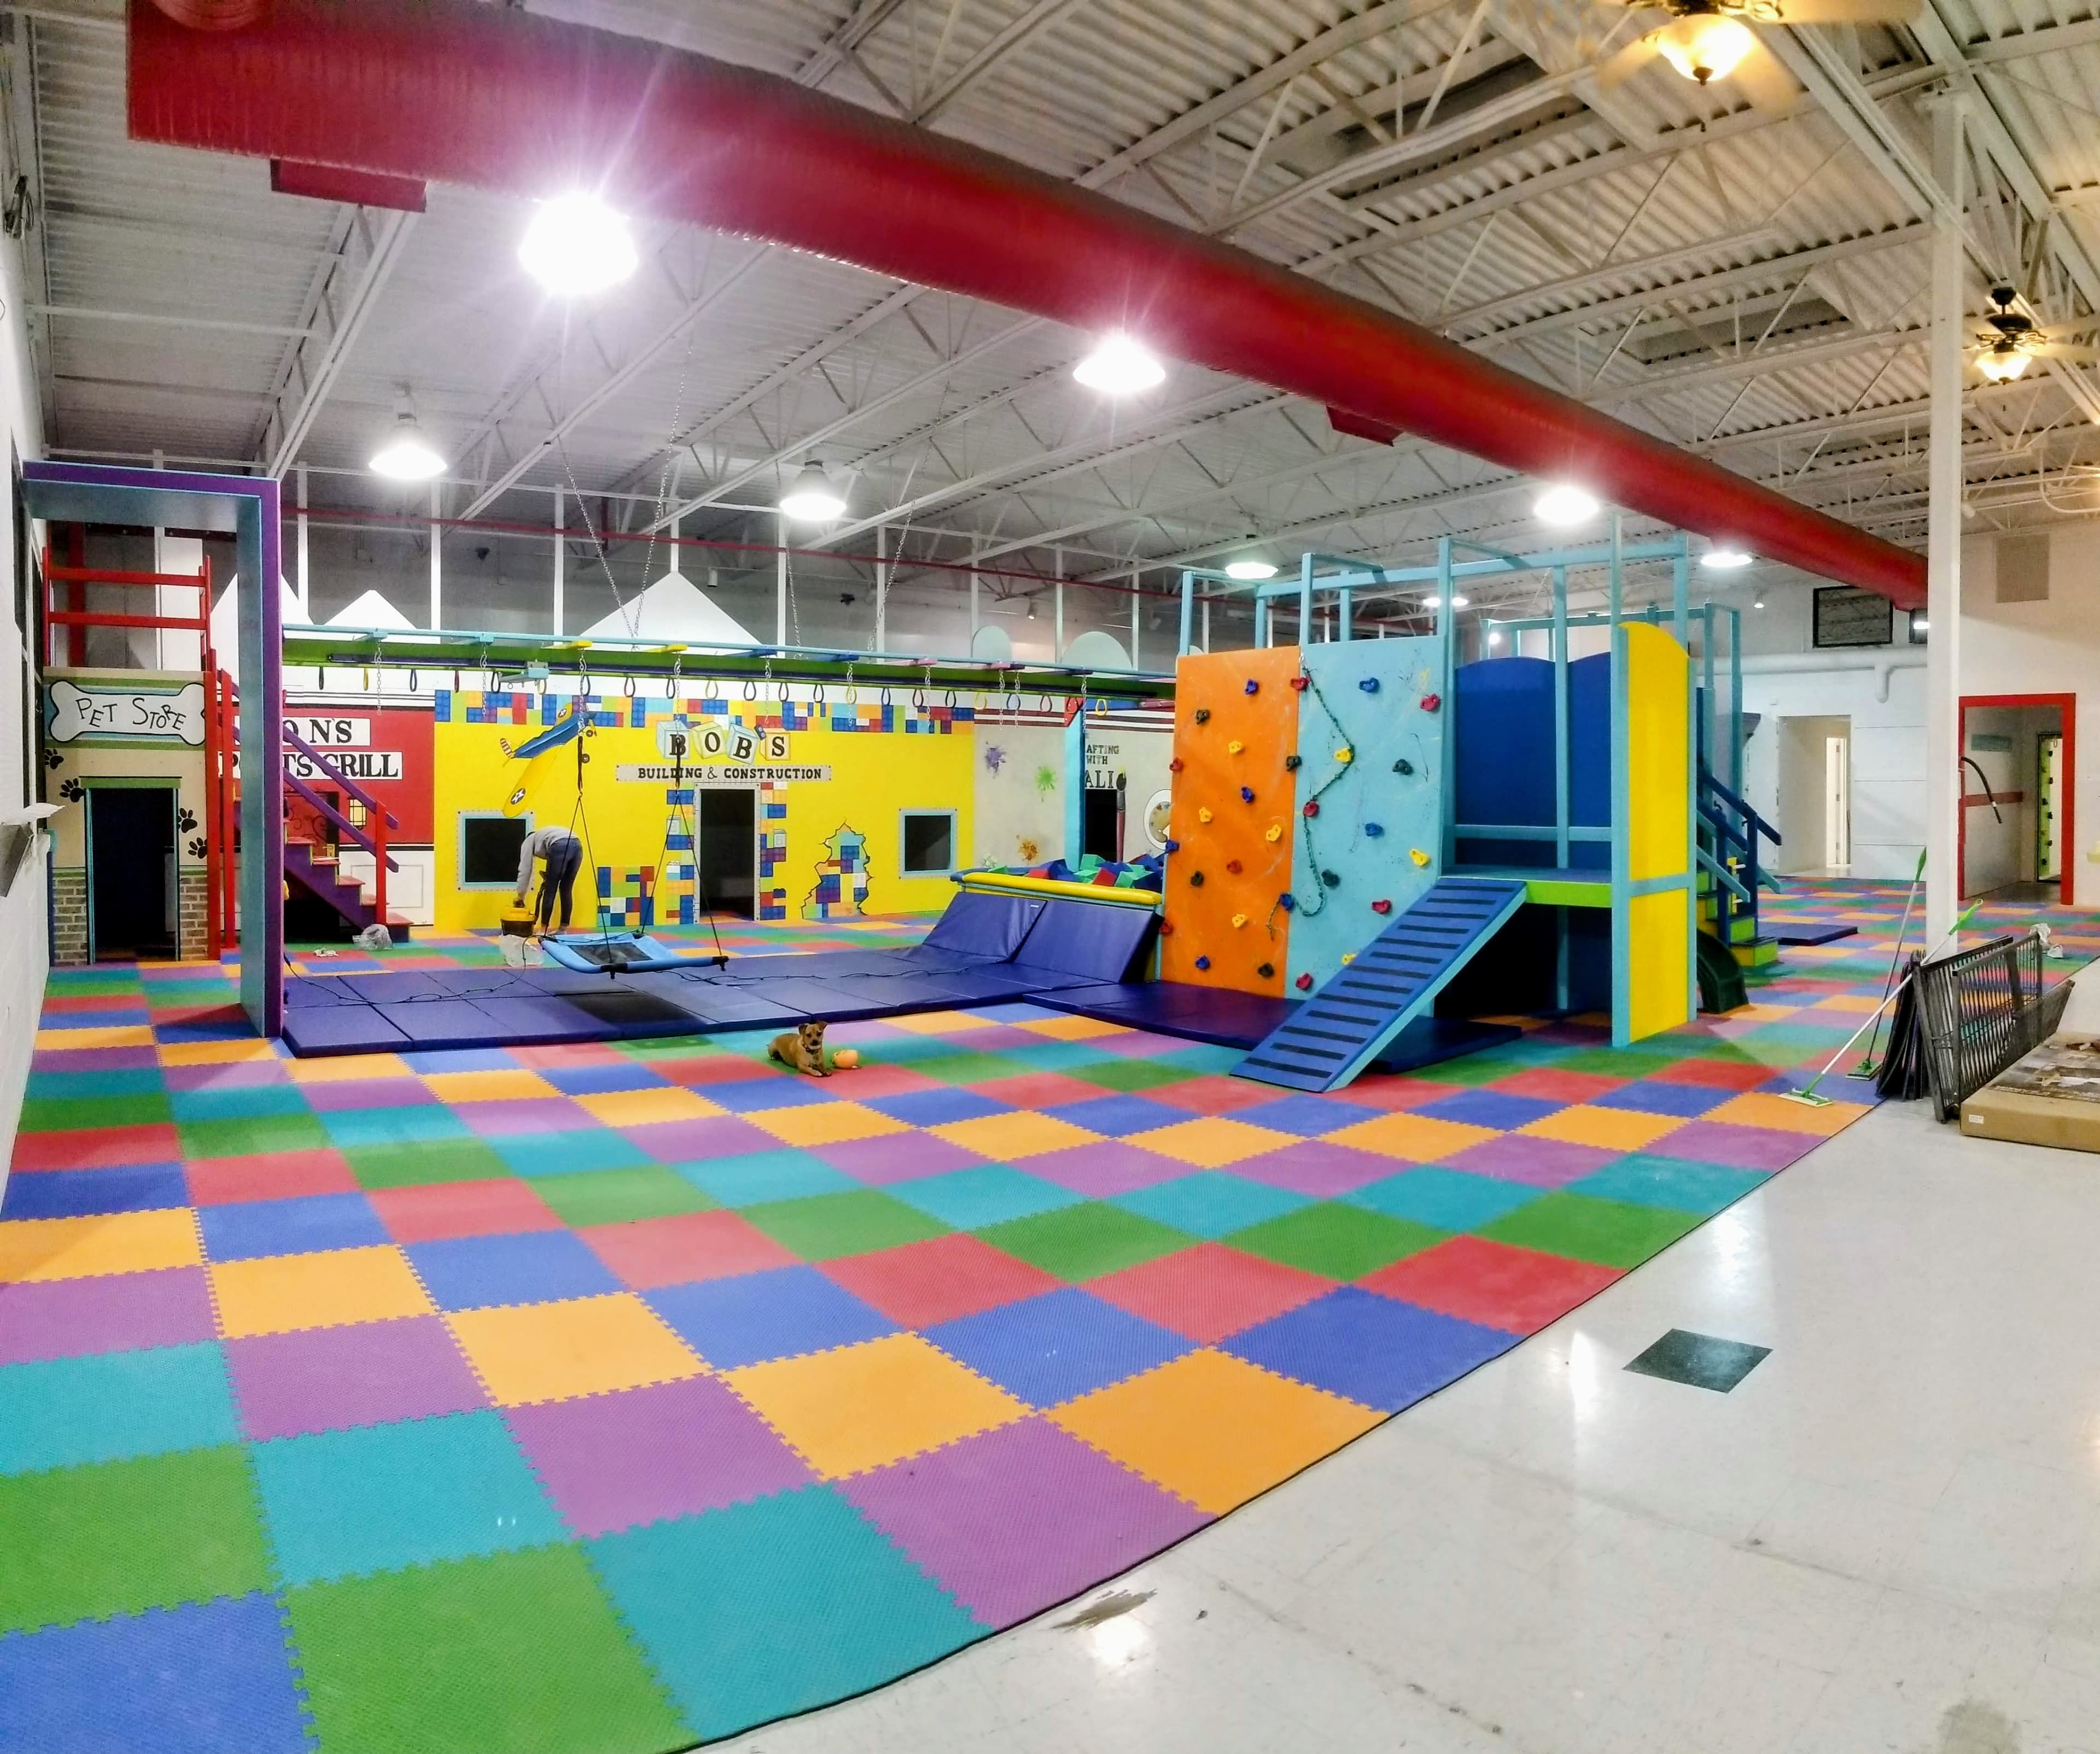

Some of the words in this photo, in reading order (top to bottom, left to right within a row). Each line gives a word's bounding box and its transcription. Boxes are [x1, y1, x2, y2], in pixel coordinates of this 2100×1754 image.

[75, 698, 118, 727] PET
[132, 697, 186, 730] STORE
[669, 731, 785, 760] BOBS
[1086, 755, 1108, 765] WITH
[638, 767, 702, 779] BUILDING
[707, 766, 718, 779] &
[724, 767, 822, 779] CONSTRUCTION
